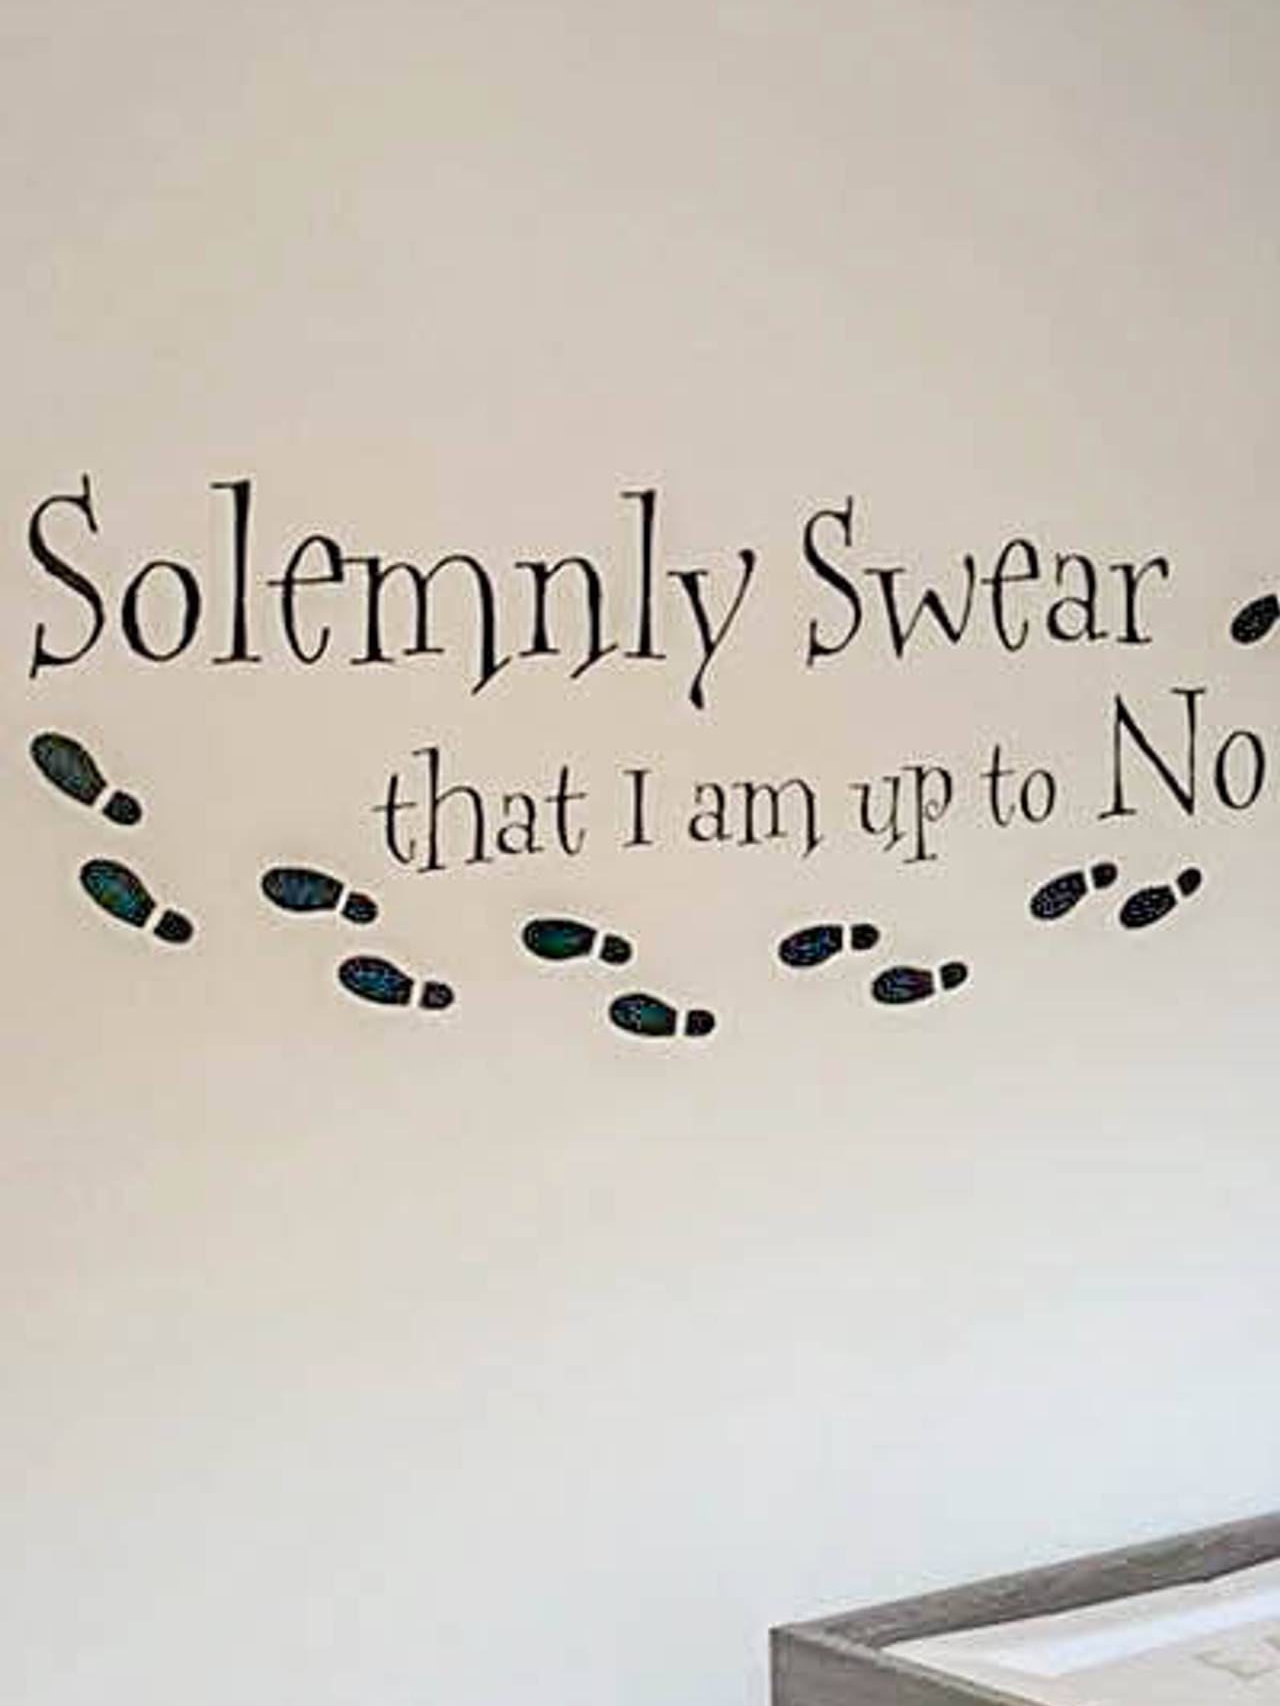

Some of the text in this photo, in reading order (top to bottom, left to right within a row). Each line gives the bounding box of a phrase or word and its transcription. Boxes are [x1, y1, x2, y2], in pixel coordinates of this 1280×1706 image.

[28, 474, 1170, 710] Solemnly Swear
[372, 747, 588, 874] that
[622, 769, 654, 847] I
[687, 779, 824, 858] am
[850, 766, 954, 862] up
[981, 743, 1058, 828] to
[1098, 686, 1266, 820] No
